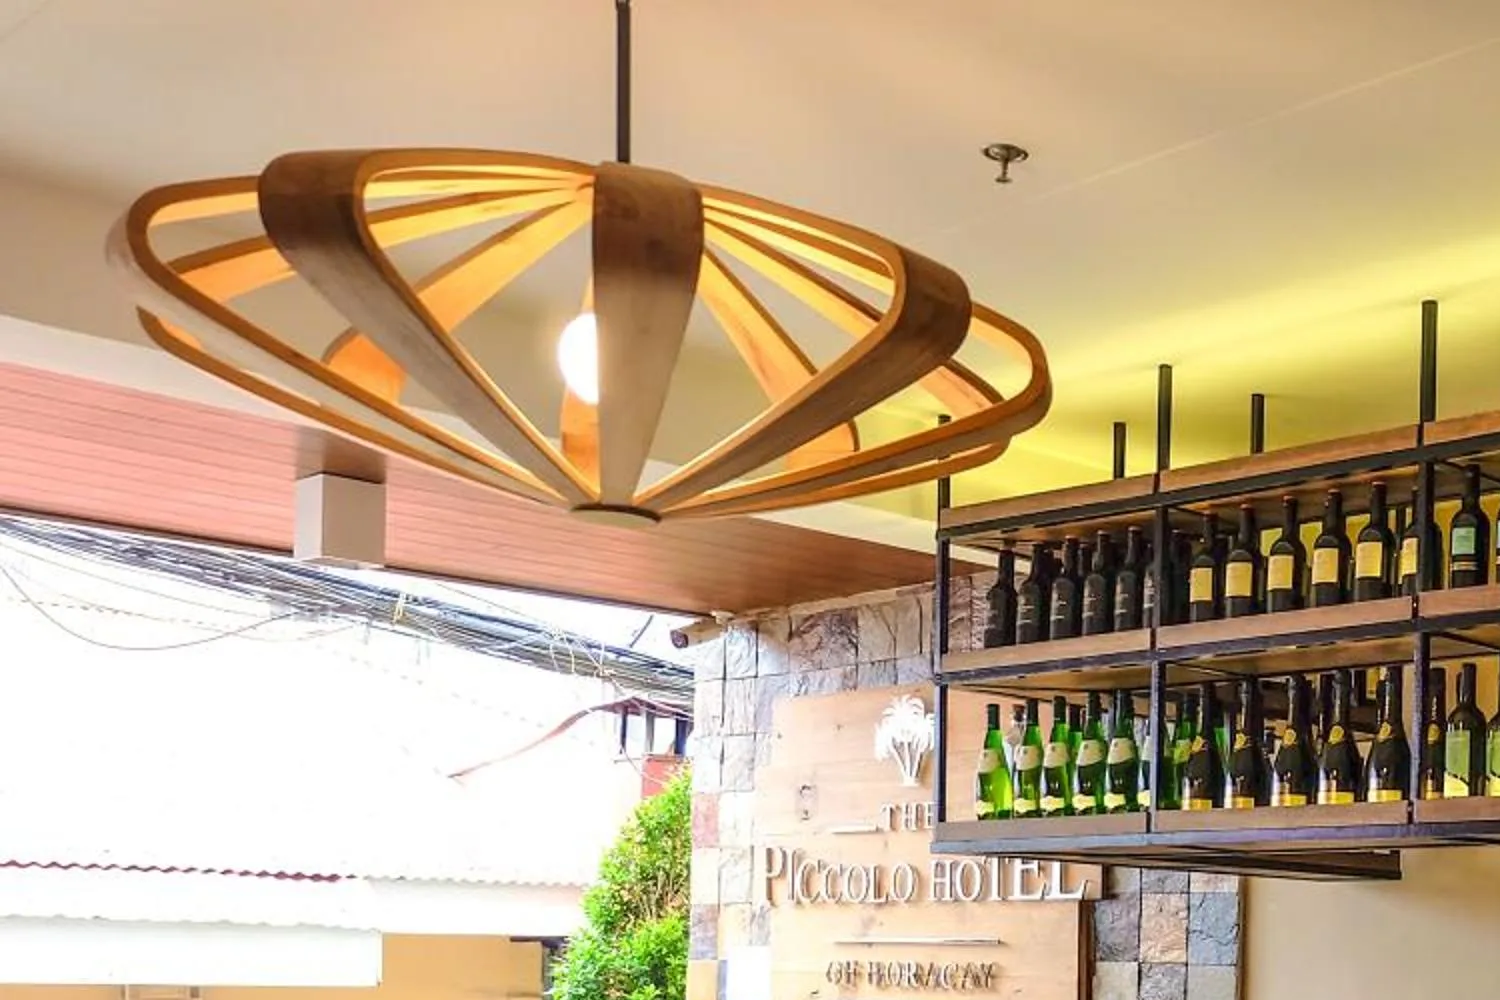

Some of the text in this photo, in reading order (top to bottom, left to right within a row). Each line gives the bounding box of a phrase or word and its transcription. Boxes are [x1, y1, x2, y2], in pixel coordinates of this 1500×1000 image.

[880, 801, 936, 832] THE
[760, 847, 1088, 905] PICCOLO HOTEL
[826, 960, 859, 988] OF
